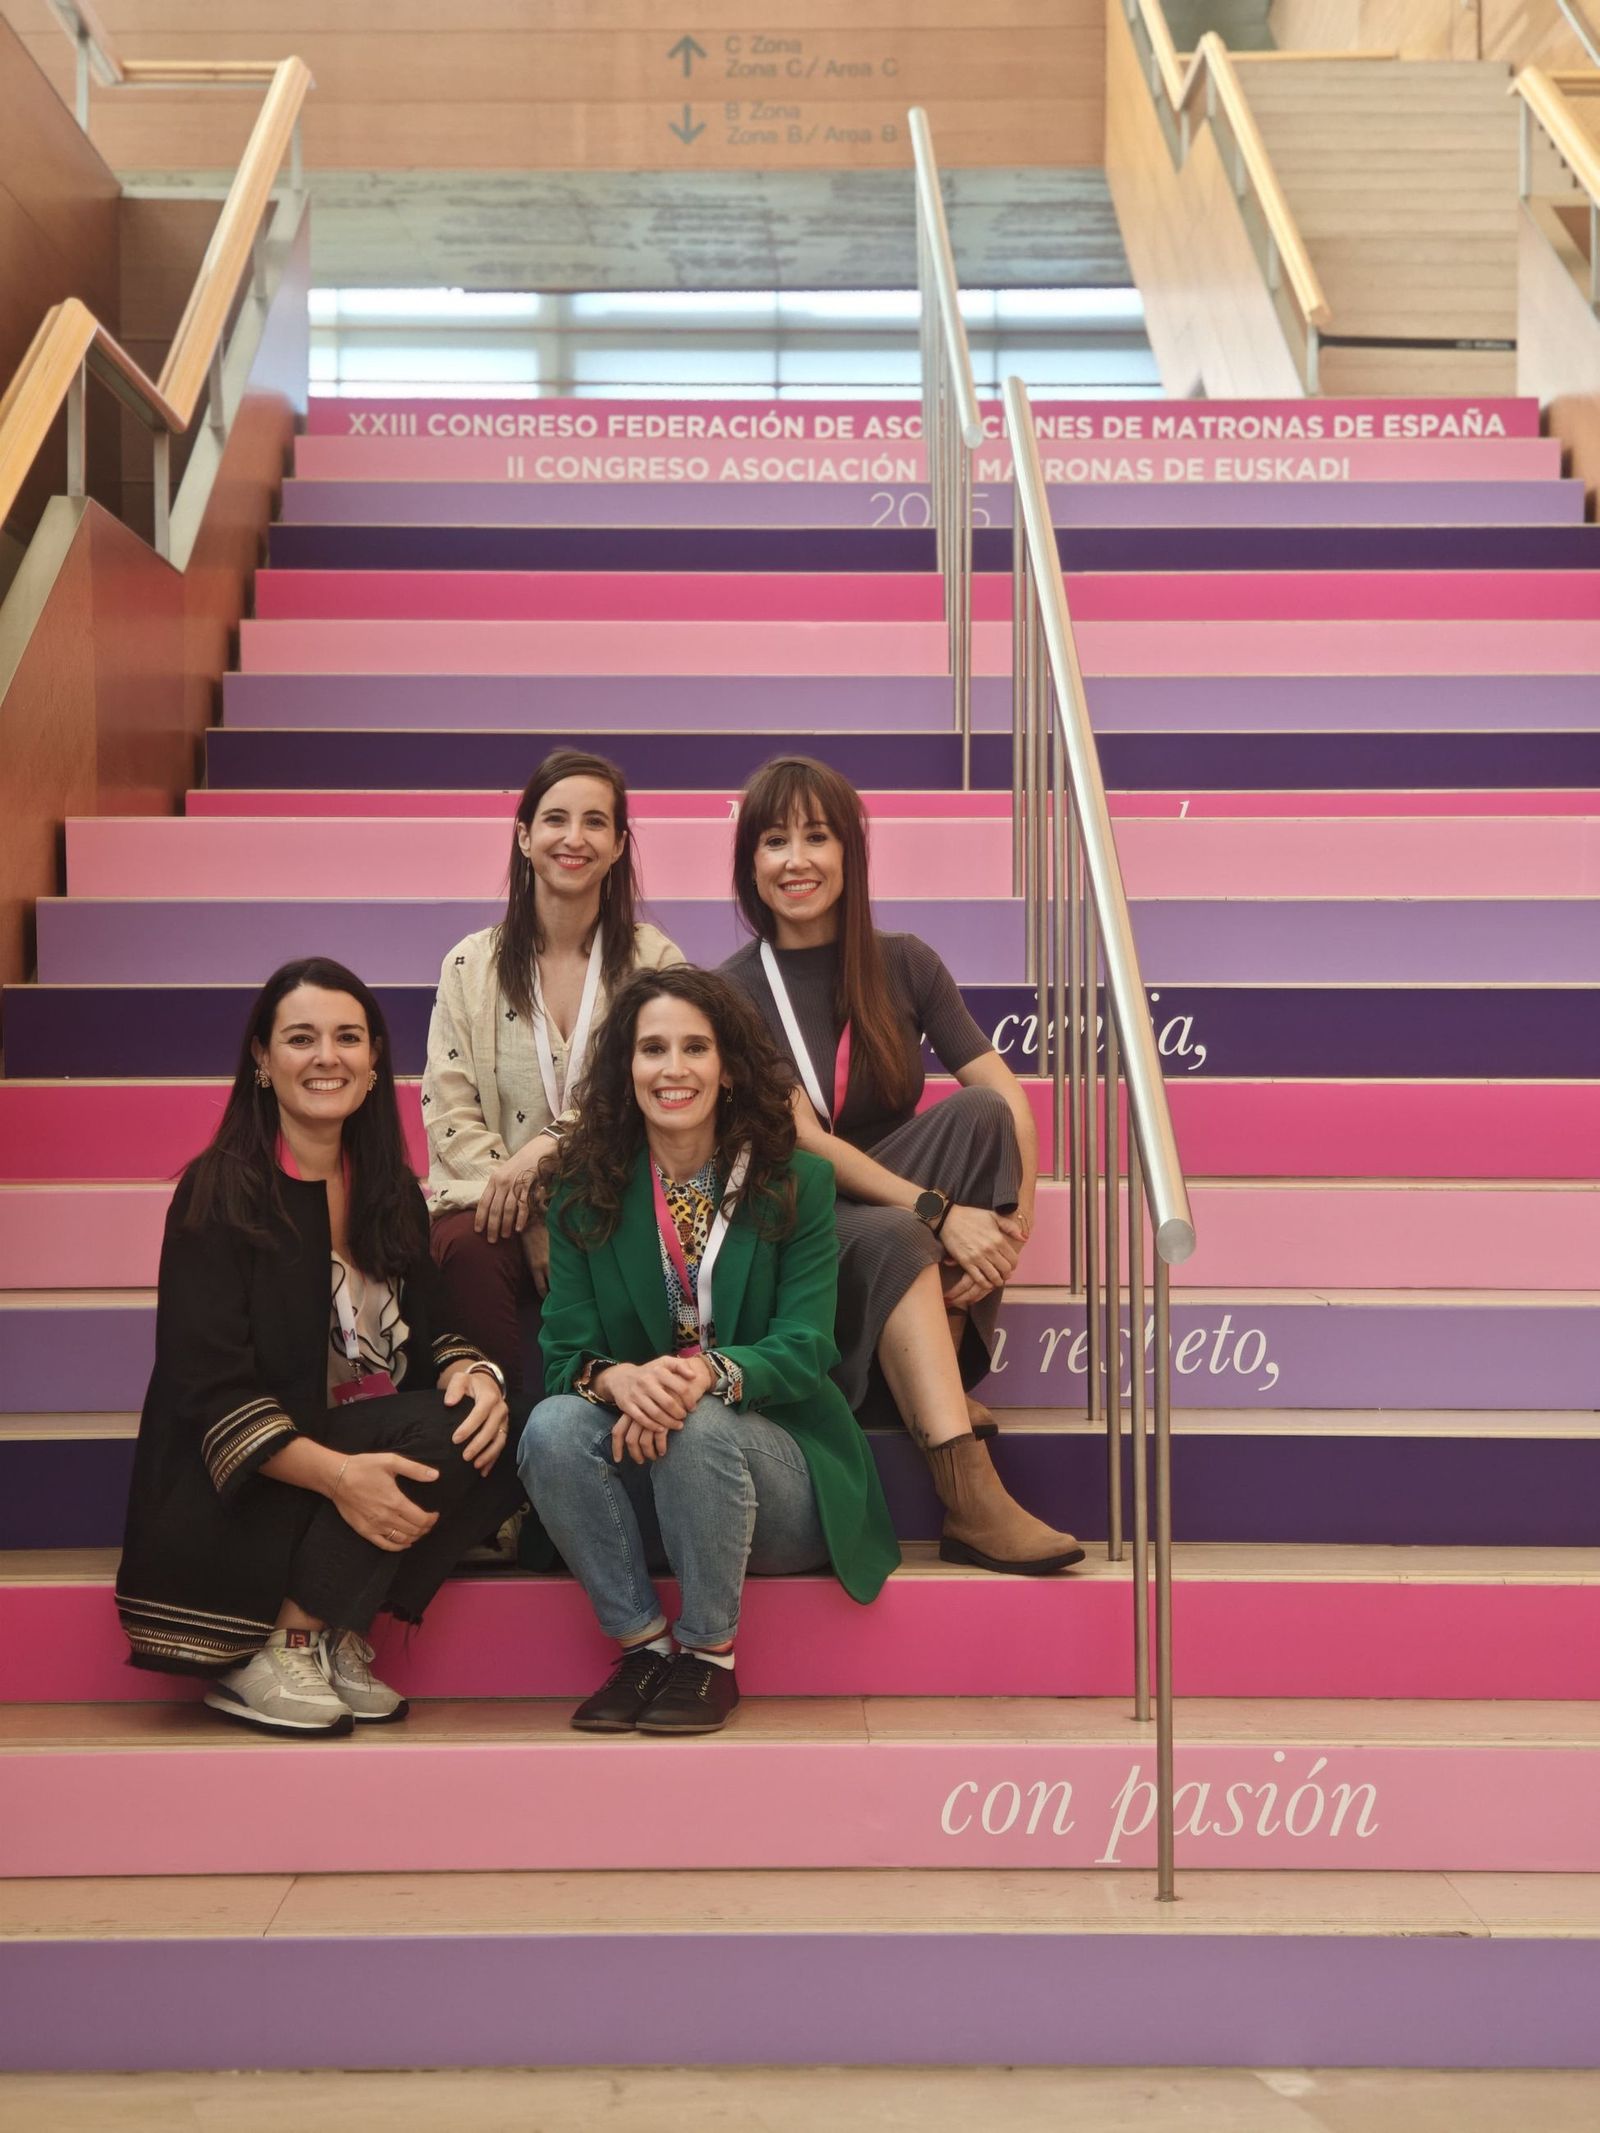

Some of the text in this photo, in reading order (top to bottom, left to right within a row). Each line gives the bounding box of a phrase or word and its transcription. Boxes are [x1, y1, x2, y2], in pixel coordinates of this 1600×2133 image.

[725, 35, 803, 55] C Zona
[725, 58, 778, 79] Zona
[881, 57, 900, 79] C
[348, 408, 1506, 440] XXIII CONGRESO FEDERACIÓN DE ASOCINES DE MATRONAS DE ESPAÑA
[507, 456, 525, 479] II
[534, 456, 709, 481] CONGRESO
[719, 452, 917, 482] ASOCIACIÓN
[978, 458, 1154, 482] MARONAS
[1163, 458, 1205, 481] DE
[1214, 456, 1350, 481] EUSKADI
[870, 492, 990, 528] 205
[940, 1750, 1380, 1864] con pasión
